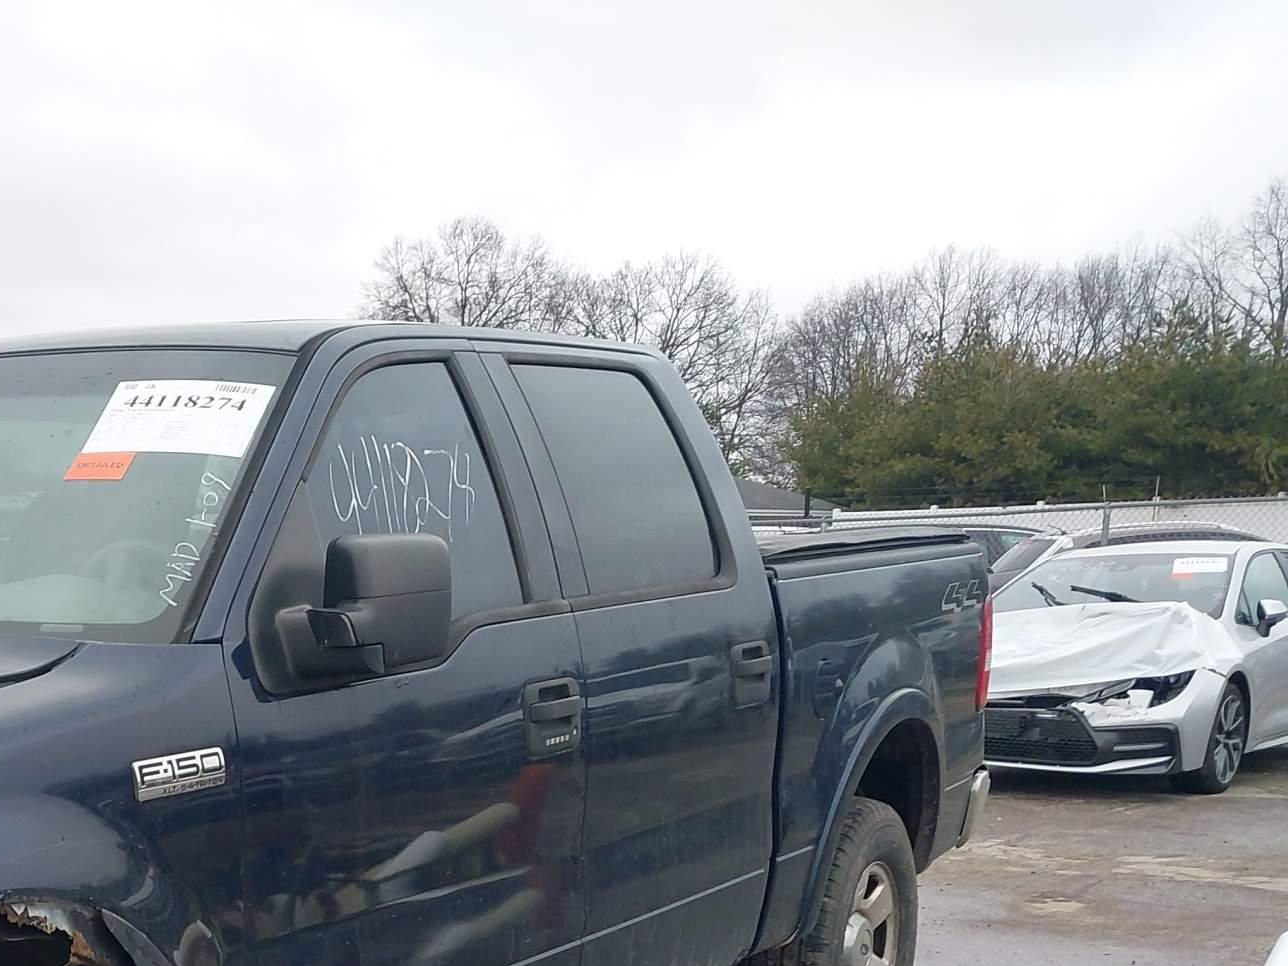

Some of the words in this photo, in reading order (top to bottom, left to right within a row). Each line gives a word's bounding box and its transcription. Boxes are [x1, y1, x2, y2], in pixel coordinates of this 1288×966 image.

[123, 393, 248, 412] 44118274
[75, 460, 125, 470] DETAILED
[159, 542, 201, 607] MAD
[137, 751, 224, 786] F-150
